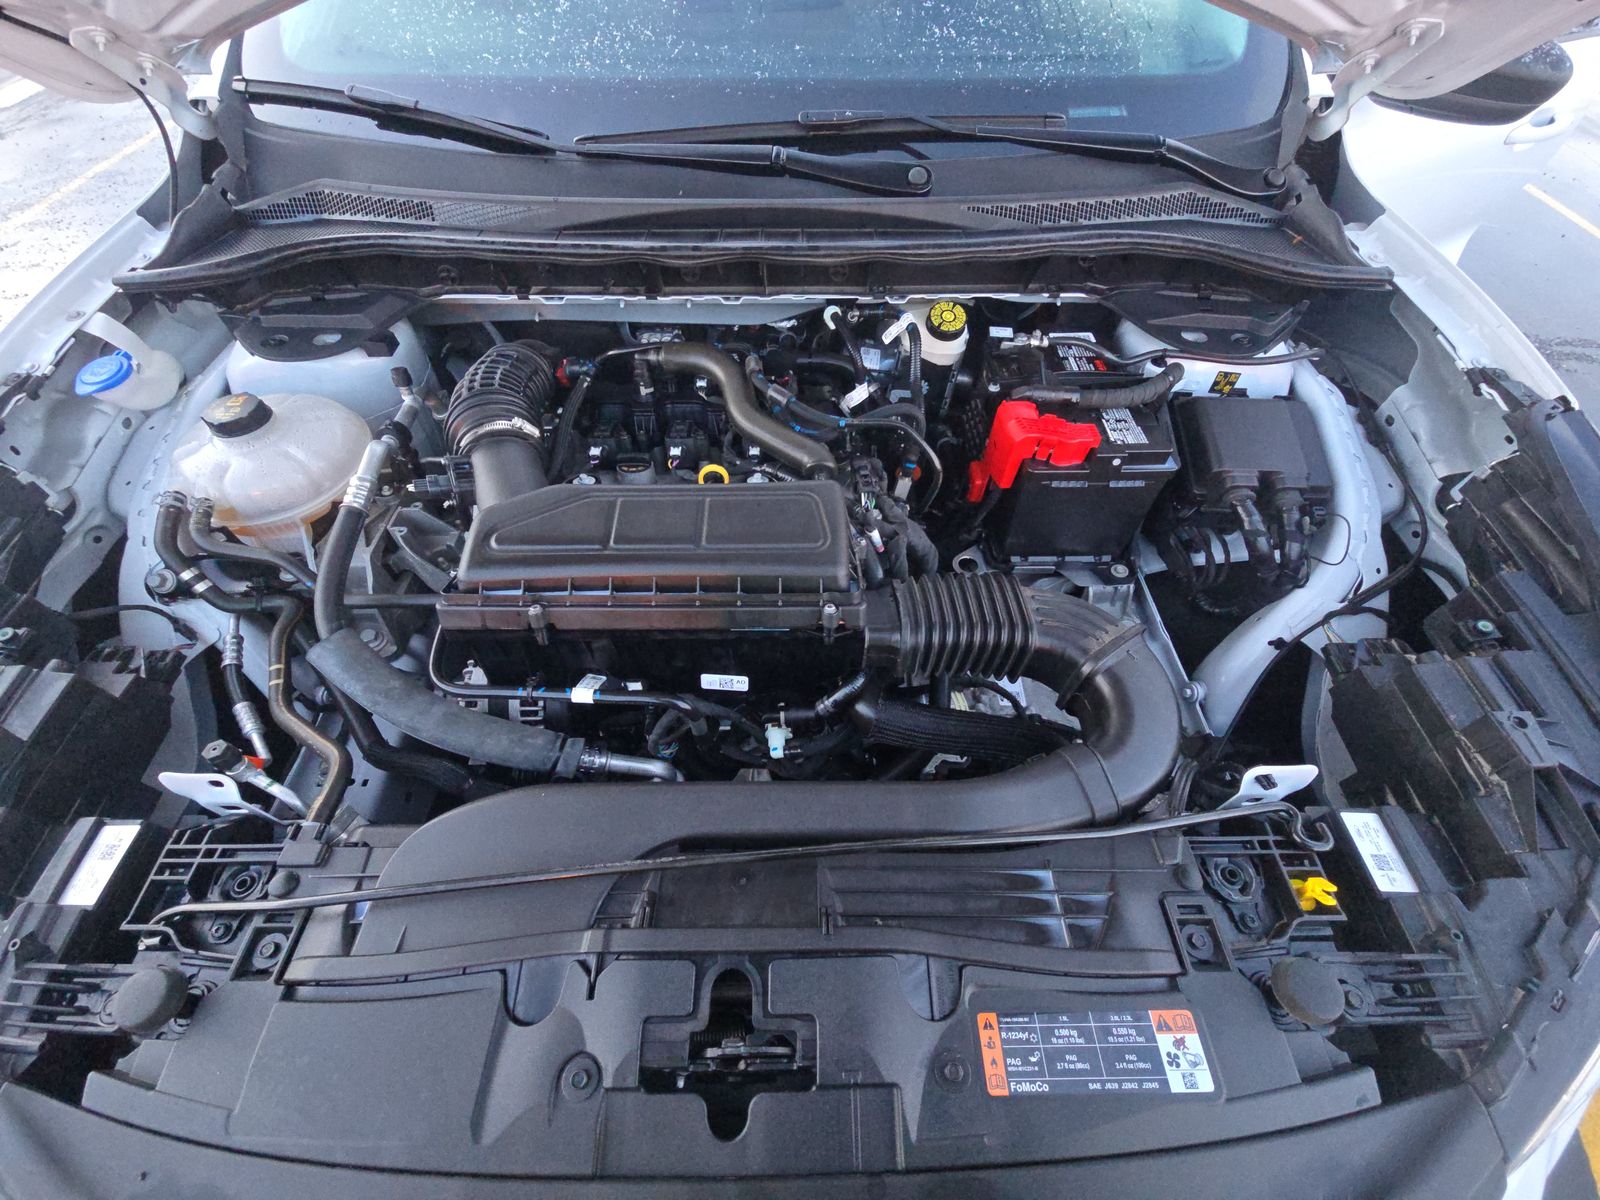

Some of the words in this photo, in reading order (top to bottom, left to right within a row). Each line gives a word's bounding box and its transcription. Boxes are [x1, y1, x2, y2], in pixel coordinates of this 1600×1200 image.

[1001, 1031, 1029, 1040] R-1234yf
[1054, 1028, 1070, 1036] 0.500
[1069, 1028, 1078, 1038] kg
[1112, 1027, 1128, 1035] 0.550
[1128, 1027, 1137, 1036] kg
[1006, 1057, 1022, 1066] PAG
[1065, 1054, 1078, 1062] PAG
[1124, 1053, 1138, 1061] PAG
[1010, 1081, 1050, 1093] FoMoCo
[1087, 1082, 1102, 1090] SAE
